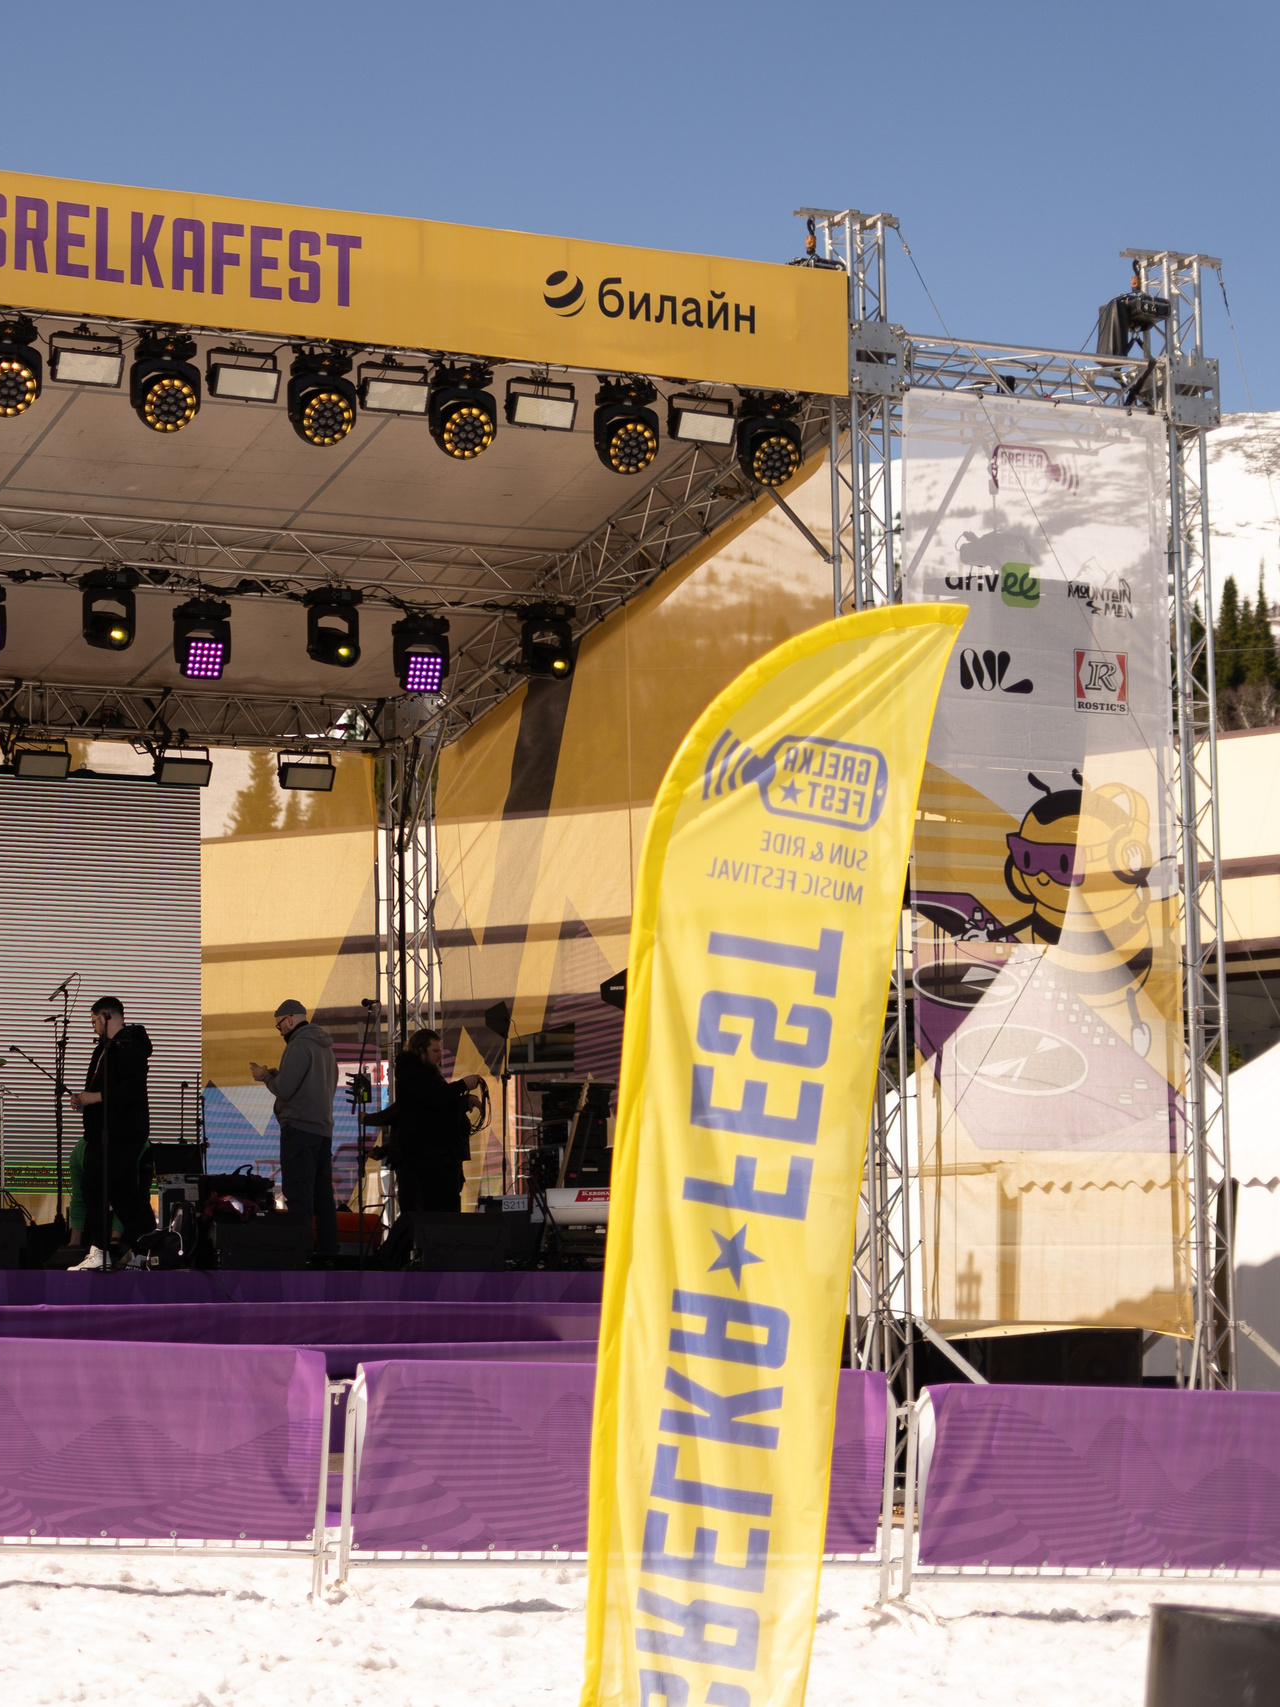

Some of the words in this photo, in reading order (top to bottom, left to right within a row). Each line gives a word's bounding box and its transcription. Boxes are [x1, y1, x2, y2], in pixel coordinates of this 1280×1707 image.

[598, 277, 756, 334] билайн
[1000, 451, 1043, 469] GRELKA
[1068, 580, 1132, 604] MOUNTAIN
[1104, 602, 1133, 619] MAN
[1077, 701, 1126, 713] ROSTIC'S
[503, 1200, 527, 1210] S211
